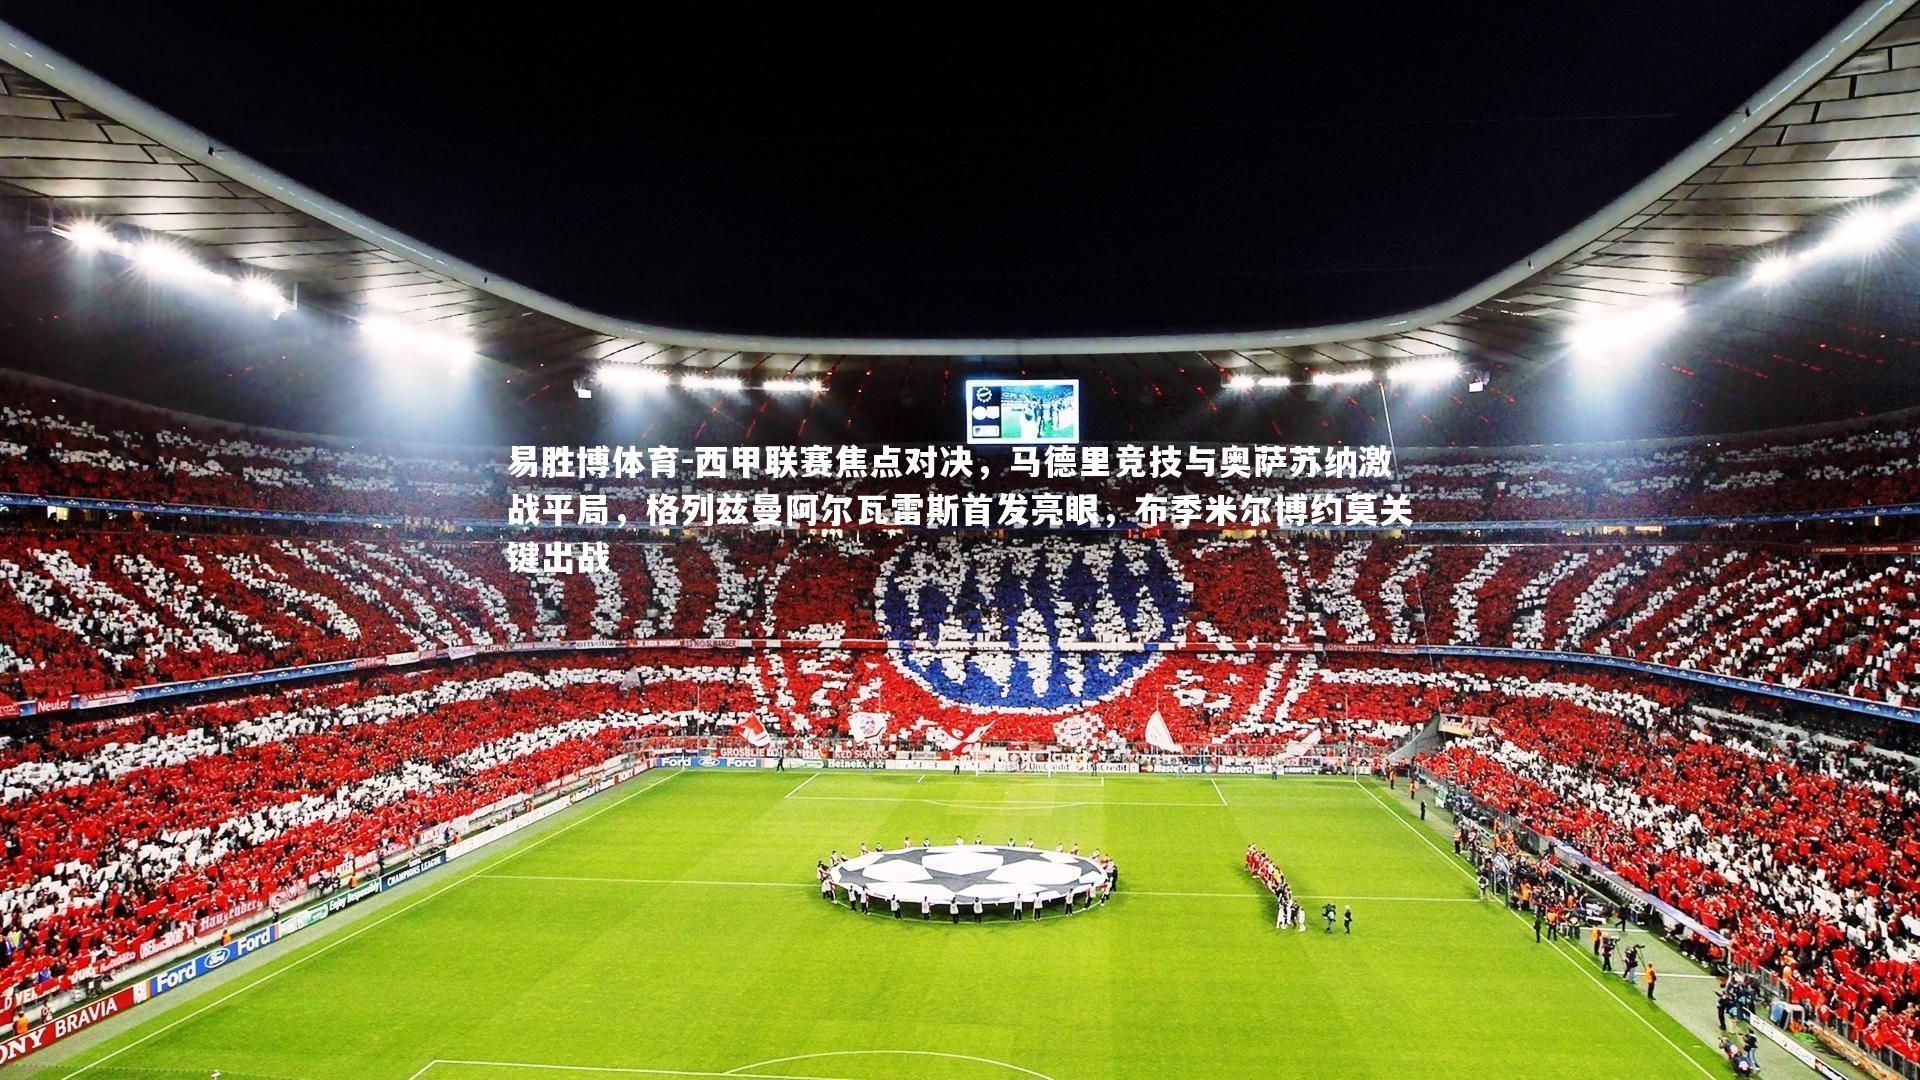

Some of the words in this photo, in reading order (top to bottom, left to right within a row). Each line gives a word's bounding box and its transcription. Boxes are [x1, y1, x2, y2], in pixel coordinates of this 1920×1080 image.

[661, 757, 691, 767] Ford
[726, 758, 757, 767] Ford
[1154, 764, 1203, 773] MasteCard
[237, 926, 271, 956] Ford
[157, 960, 197, 993] Ford
[0, 1027, 46, 1065] ONY
[55, 997, 118, 1038] BRAVIA
